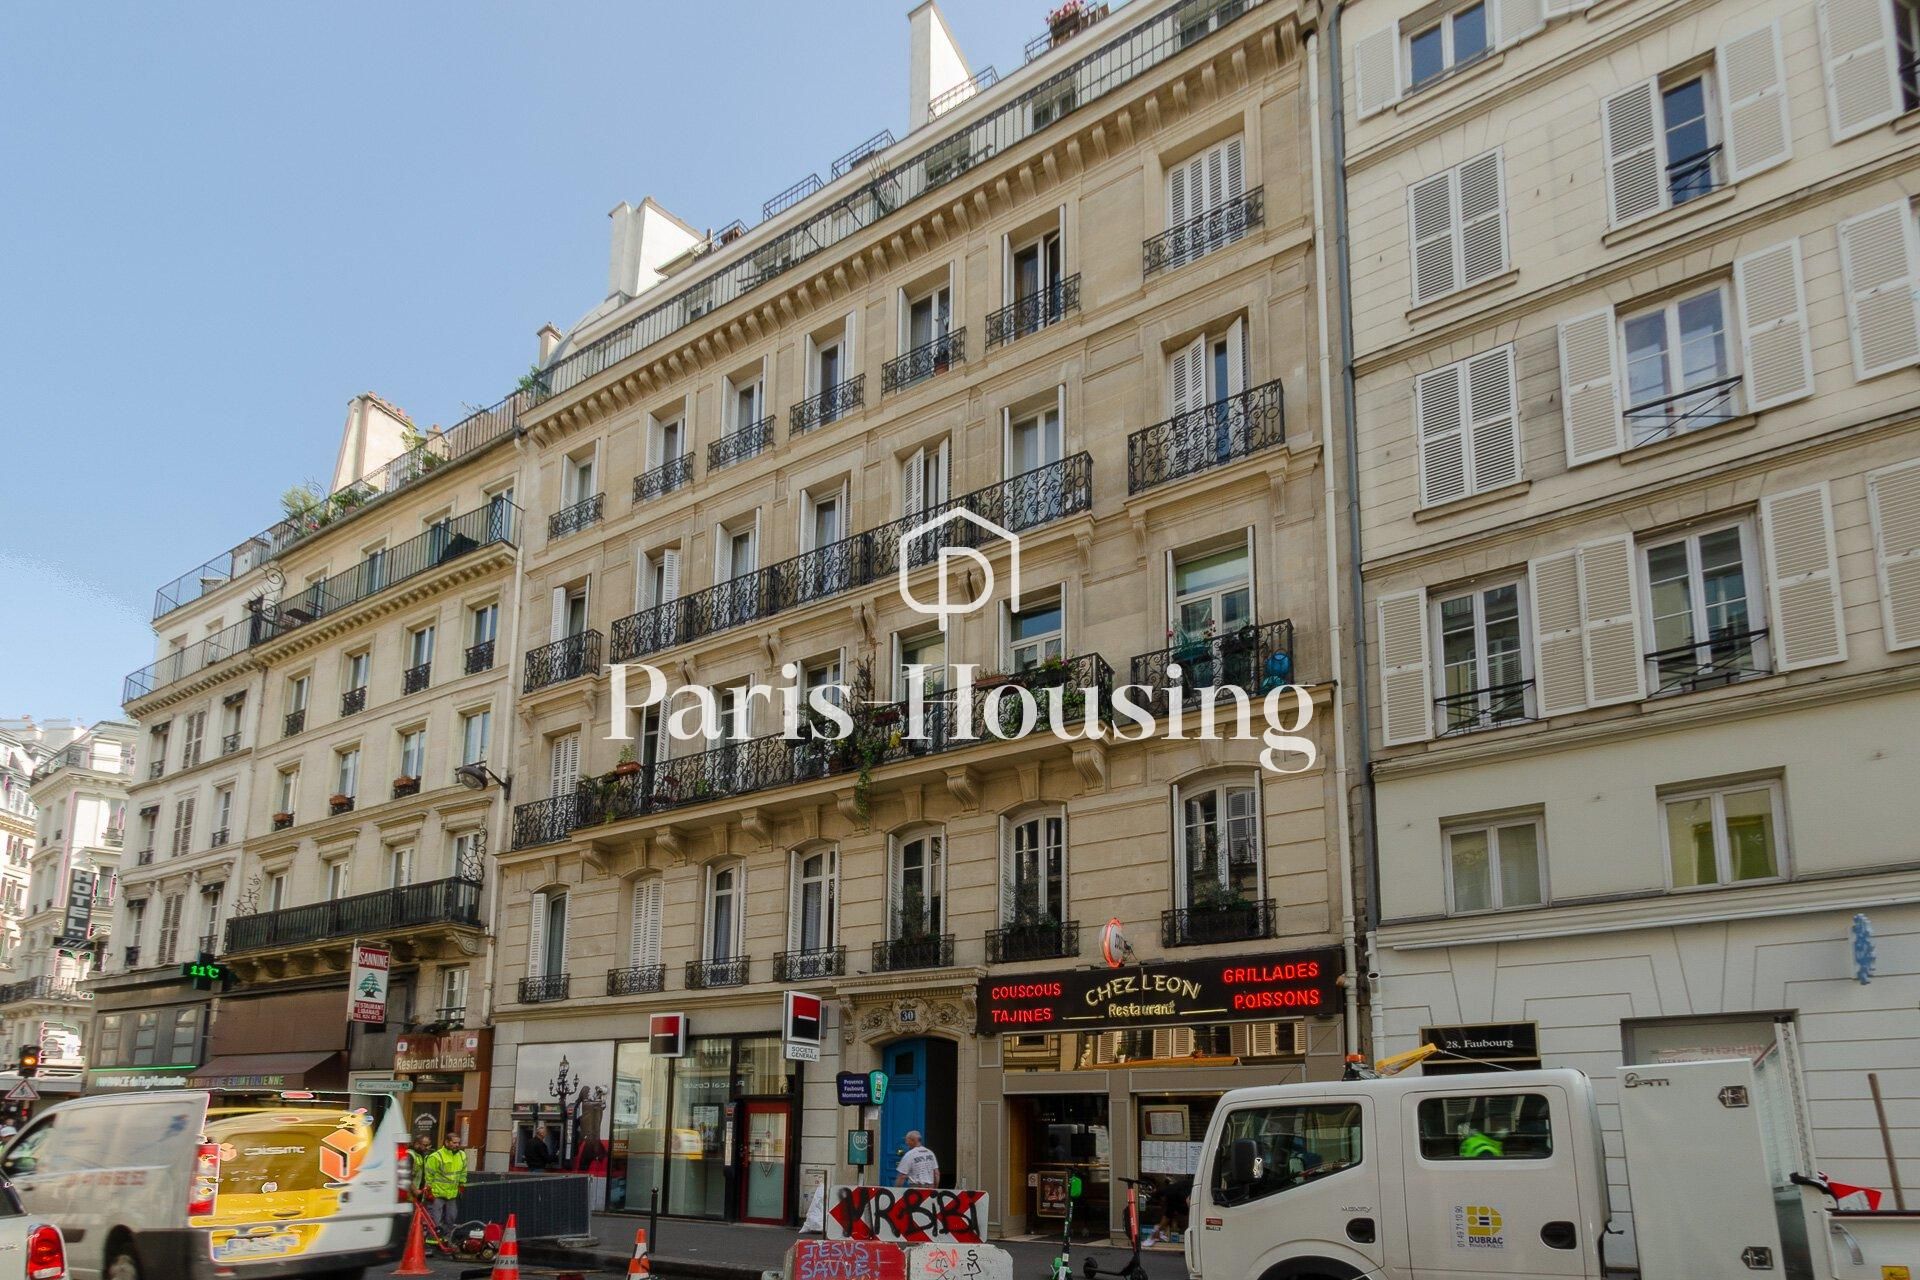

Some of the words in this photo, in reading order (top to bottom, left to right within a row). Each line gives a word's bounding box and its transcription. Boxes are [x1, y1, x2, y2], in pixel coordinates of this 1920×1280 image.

[66, 870, 94, 931] HOTEL
[359, 951, 389, 969] SANNINE
[1223, 962, 1318, 984] GRILLADES
[991, 982, 1062, 1001] COUSCOUS
[1086, 976, 1139, 1006] CHEZ
[1142, 974, 1201, 1000] LEON
[1233, 989, 1320, 1010] POISSONS
[901, 1011, 914, 1021] 30
[991, 1007, 1053, 1024] TAJINES
[1108, 1000, 1176, 1018] Restaurant
[1464, 1040, 1514, 1049] Faubourg
[396, 1057, 439, 1071] Restaurant
[440, 1054, 475, 1068] Libanais
[855, 1135, 868, 1145] BUS
[1469, 1236, 1504, 1245] DUBRAC
[801, 1242, 869, 1260] JESUS
